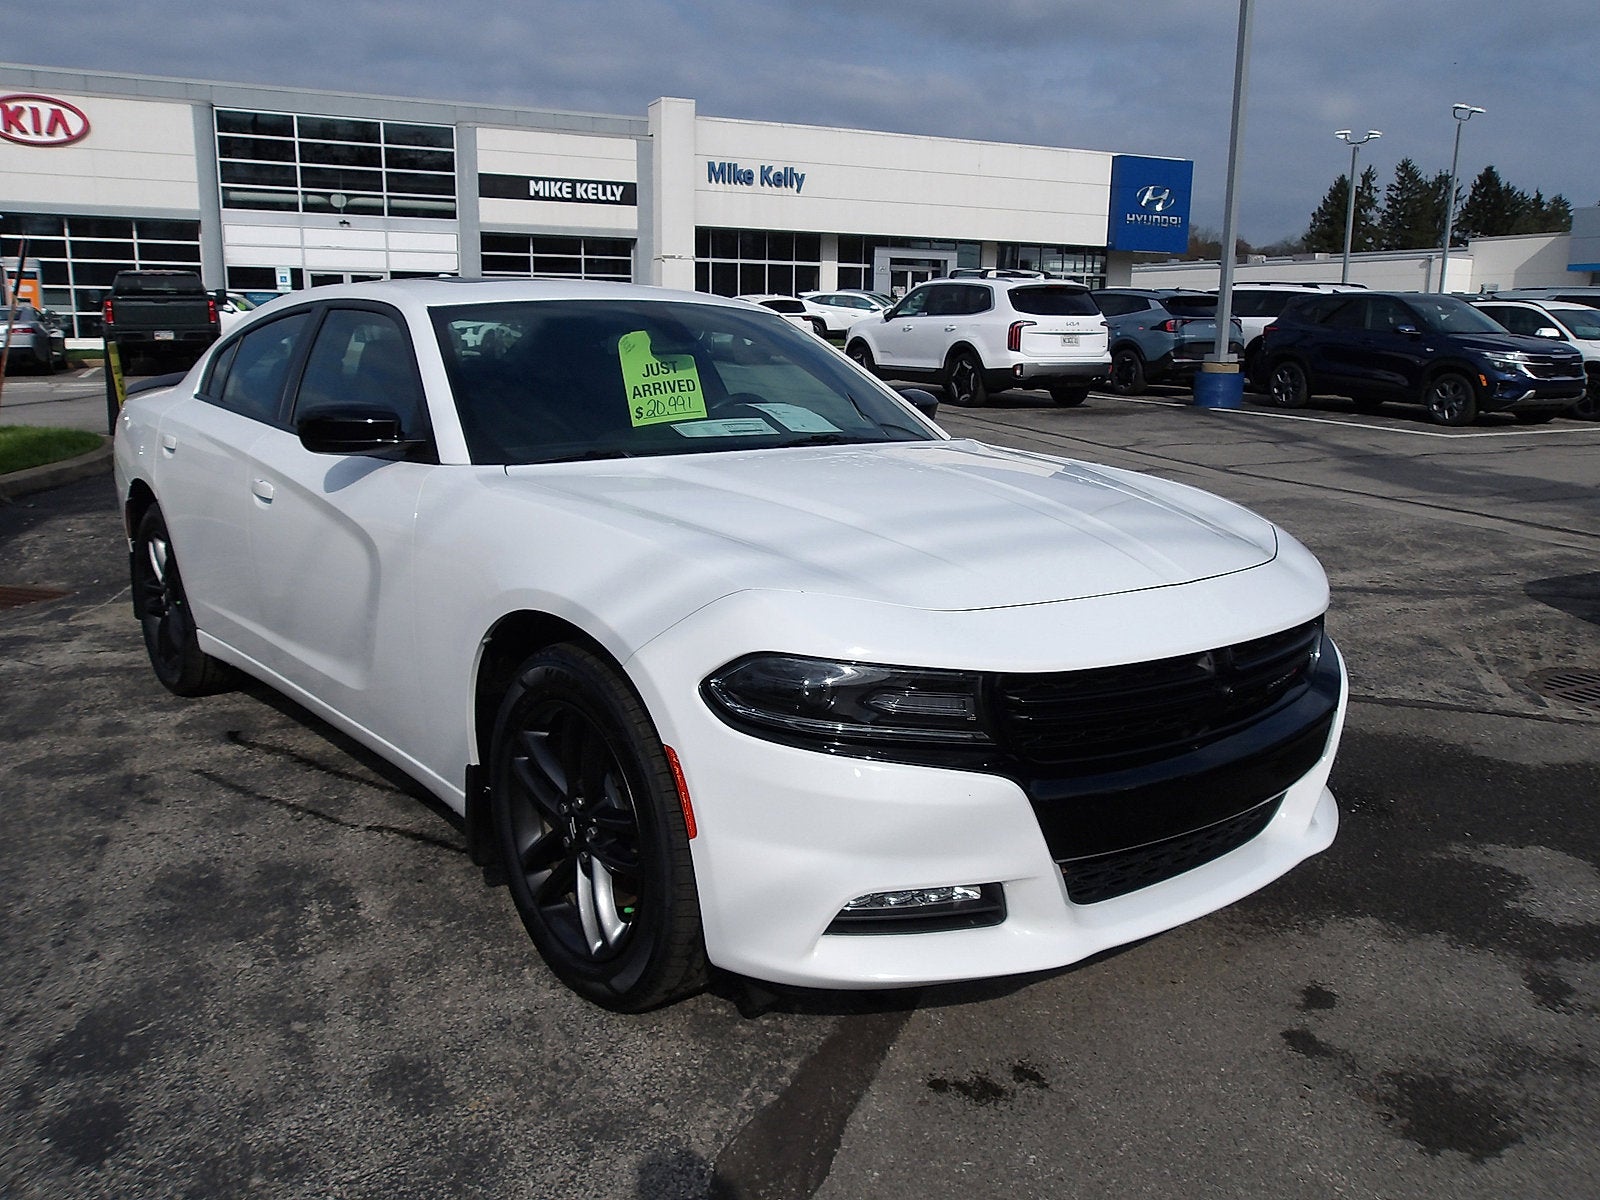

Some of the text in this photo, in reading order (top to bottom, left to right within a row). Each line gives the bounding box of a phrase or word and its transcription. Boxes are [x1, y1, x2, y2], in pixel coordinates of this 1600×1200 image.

[0, 103, 72, 135] KIA
[707, 161, 806, 193] Mike Kelly
[529, 180, 624, 201] MIKE KELLY
[1126, 213, 1182, 228] HYUNDAI
[642, 361, 678, 377] JUST
[632, 379, 696, 399] ARRIVED
